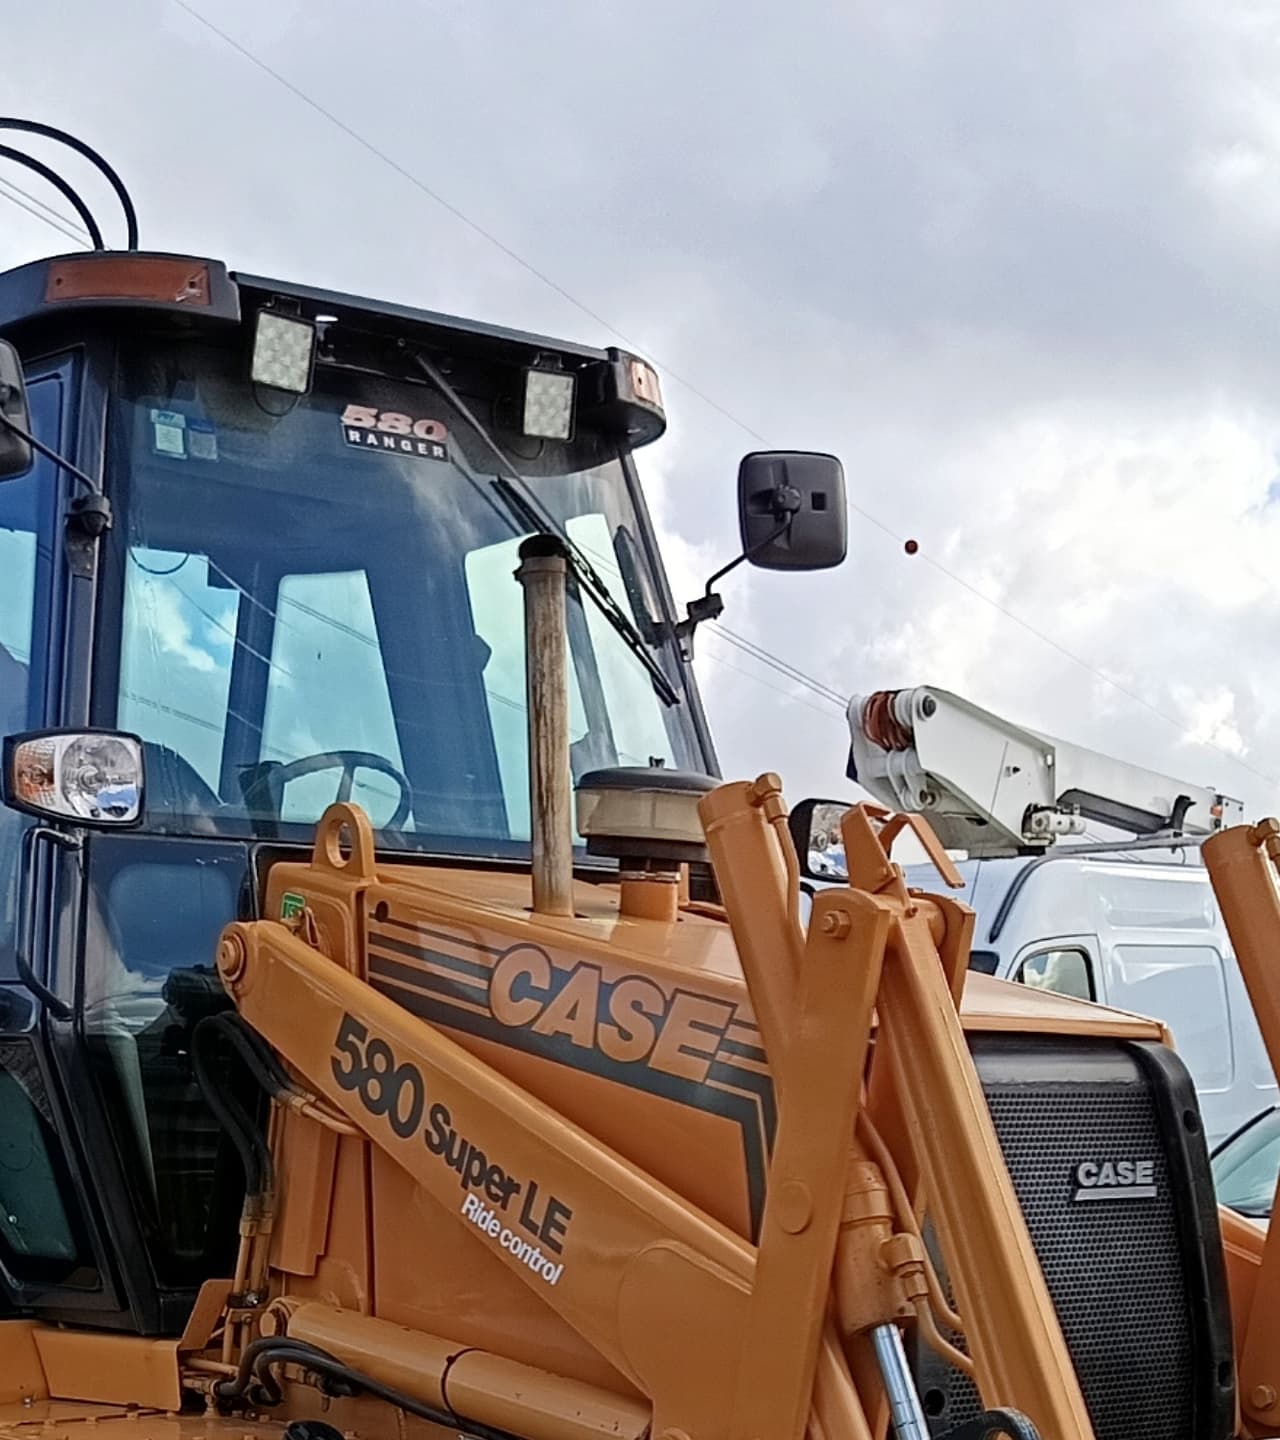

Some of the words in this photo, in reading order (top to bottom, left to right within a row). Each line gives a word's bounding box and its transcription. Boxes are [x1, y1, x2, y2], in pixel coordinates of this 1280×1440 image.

[341, 404, 448, 442] 580
[348, 429, 445, 458] RANGER
[488, 943, 737, 1084] CASE
[330, 1012, 425, 1139] 580
[424, 1103, 522, 1211] Super
[519, 1180, 573, 1256] LE
[1076, 1160, 1155, 1188] CASE
[461, 1192, 501, 1238] Ride
[499, 1231, 564, 1286] control
